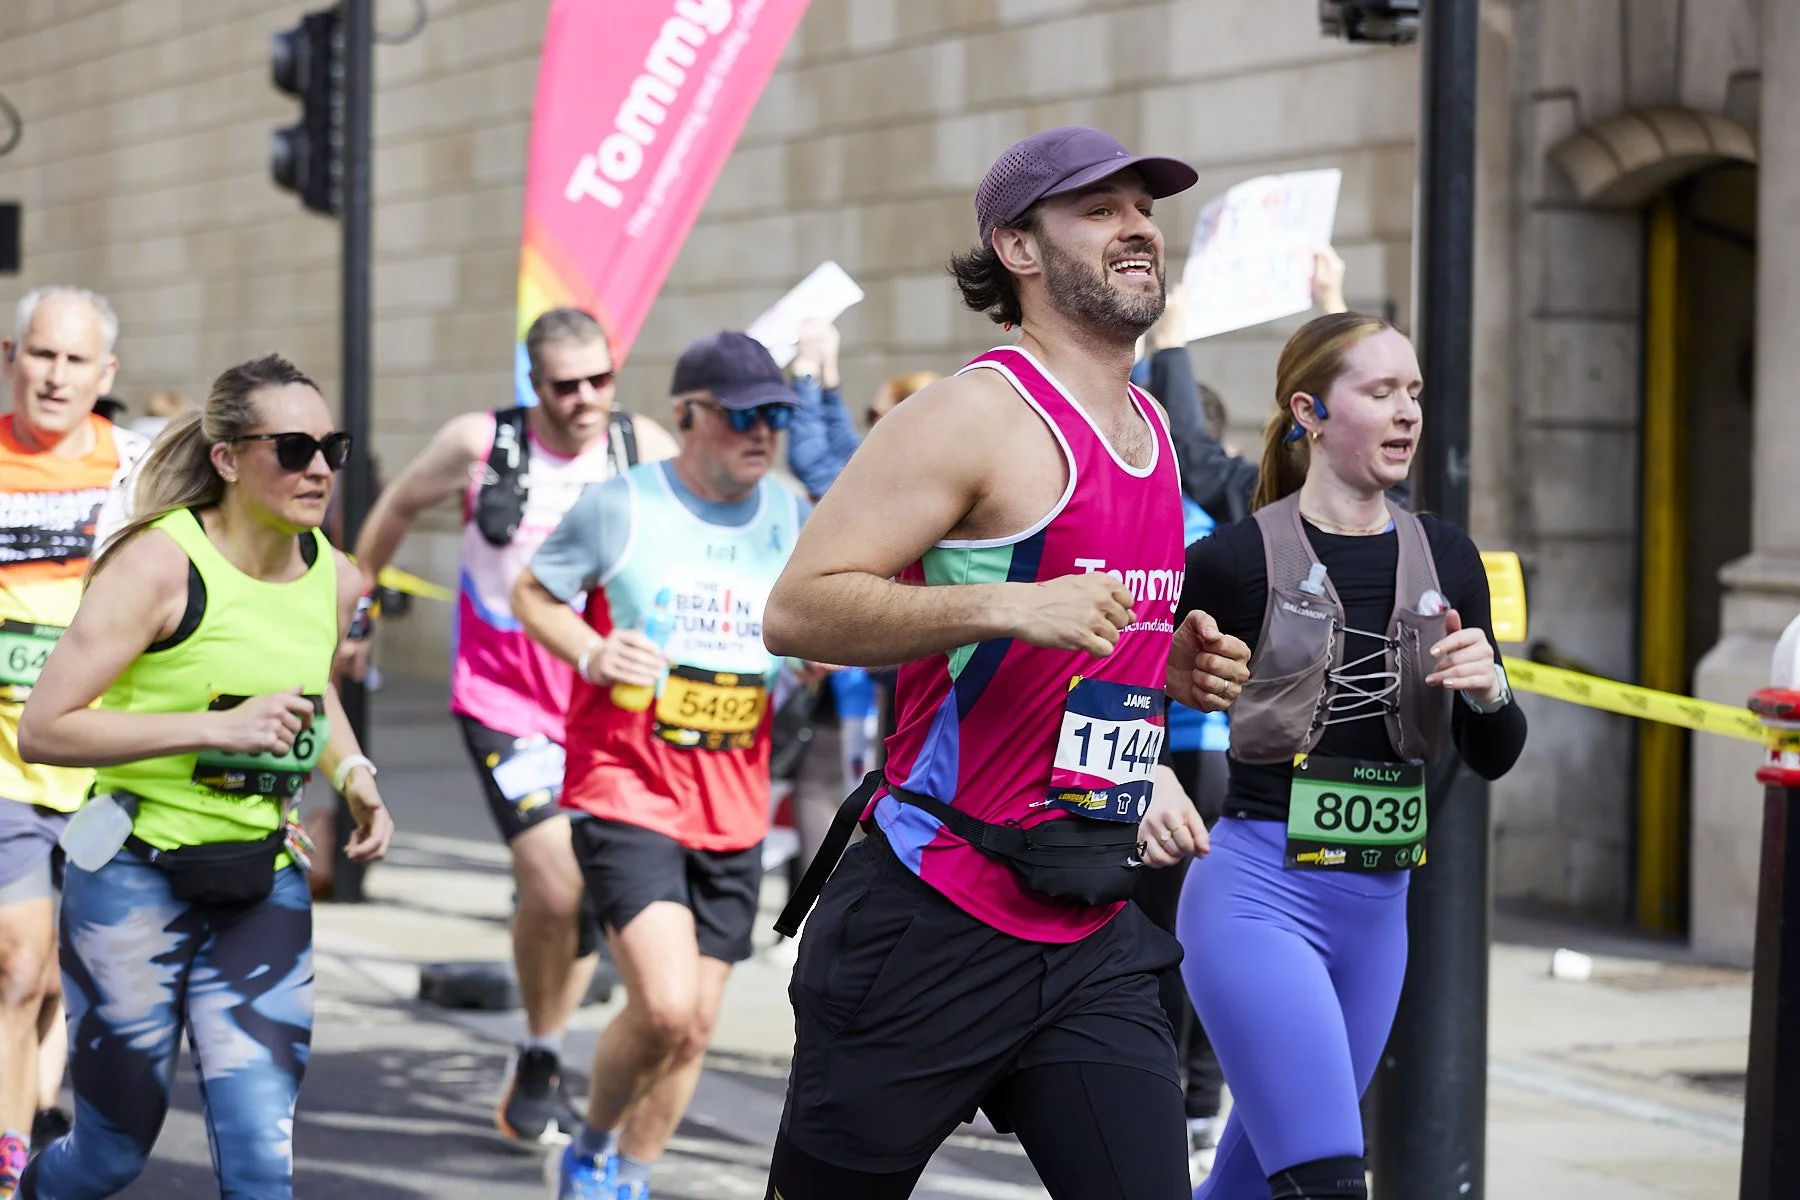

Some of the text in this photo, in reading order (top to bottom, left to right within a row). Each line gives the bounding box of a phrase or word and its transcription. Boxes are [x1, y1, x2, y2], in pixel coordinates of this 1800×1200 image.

[676, 588, 751, 616] BRAIN
[1282, 601, 1328, 620] SALOMON
[679, 689, 758, 722] 5492
[1123, 693, 1152, 710] JAMIE
[1353, 766, 1402, 782] MOLLY
[1314, 792, 1421, 834] 8039
